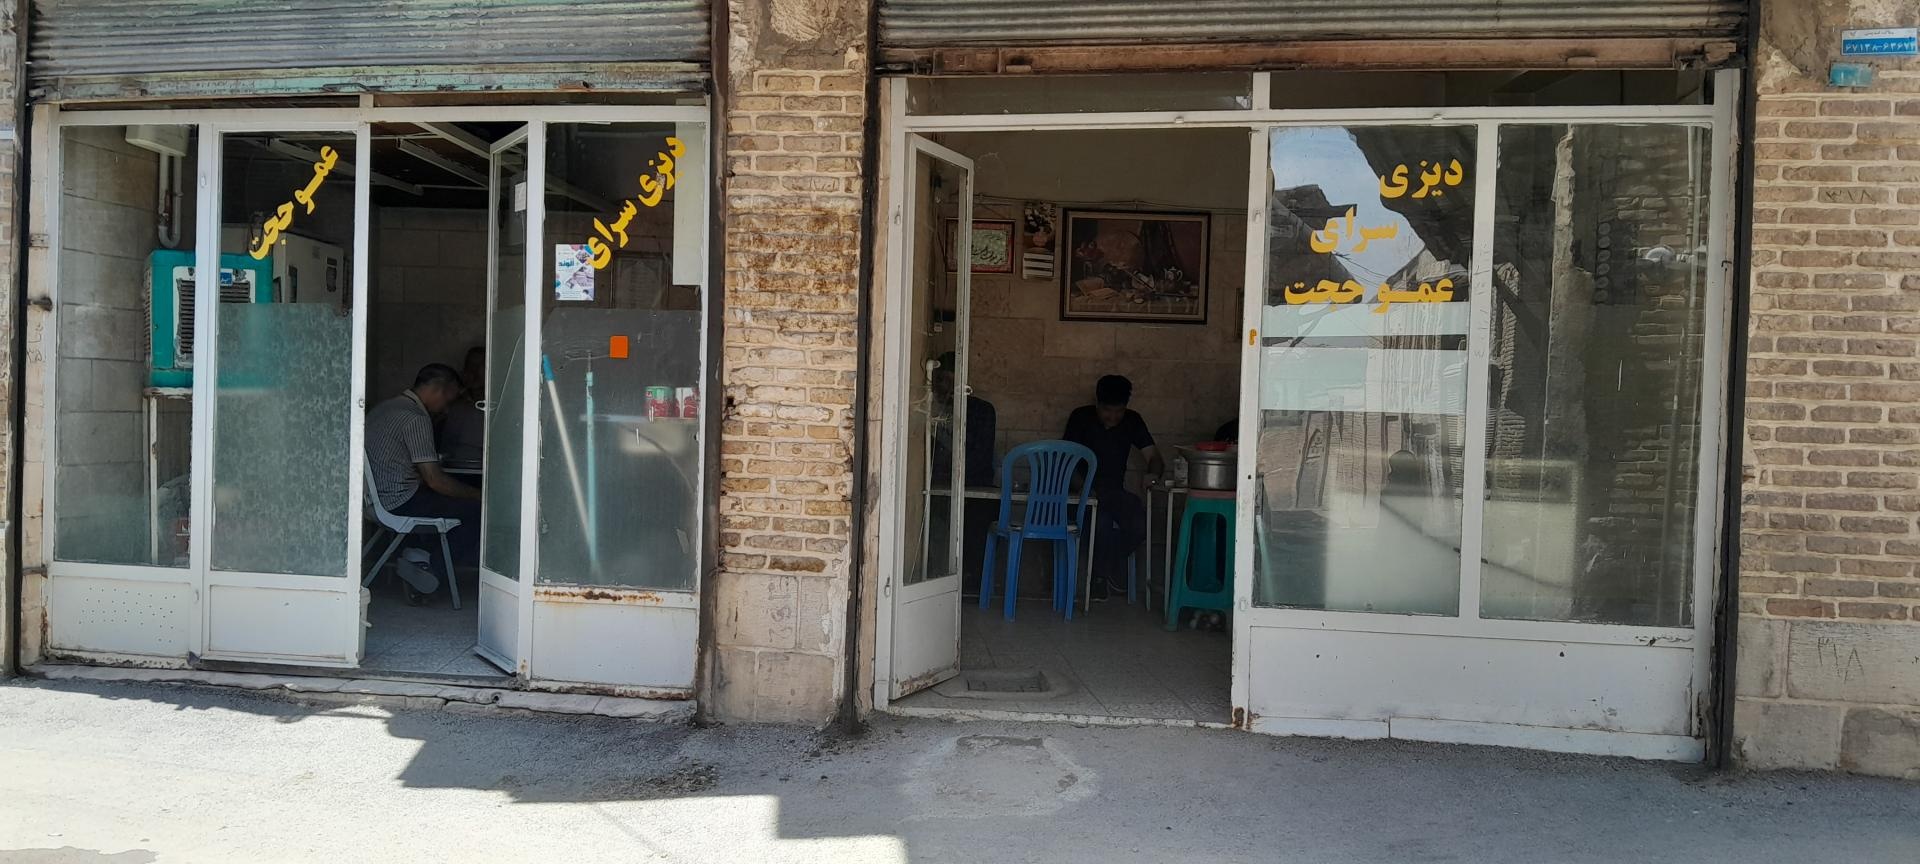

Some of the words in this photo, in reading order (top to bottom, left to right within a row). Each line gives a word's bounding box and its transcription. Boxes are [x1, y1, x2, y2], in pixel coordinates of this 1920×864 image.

[294, 145, 339, 215] عمو
[638, 136, 687, 208] دیزی
[1379, 158, 1464, 199] دیزی
[249, 201, 295, 261] حجت
[585, 200, 638, 271] سرای
[1310, 207, 1398, 254] سرای
[1284, 277, 1364, 311] حجت
[1373, 277, 1454, 314] عمو
